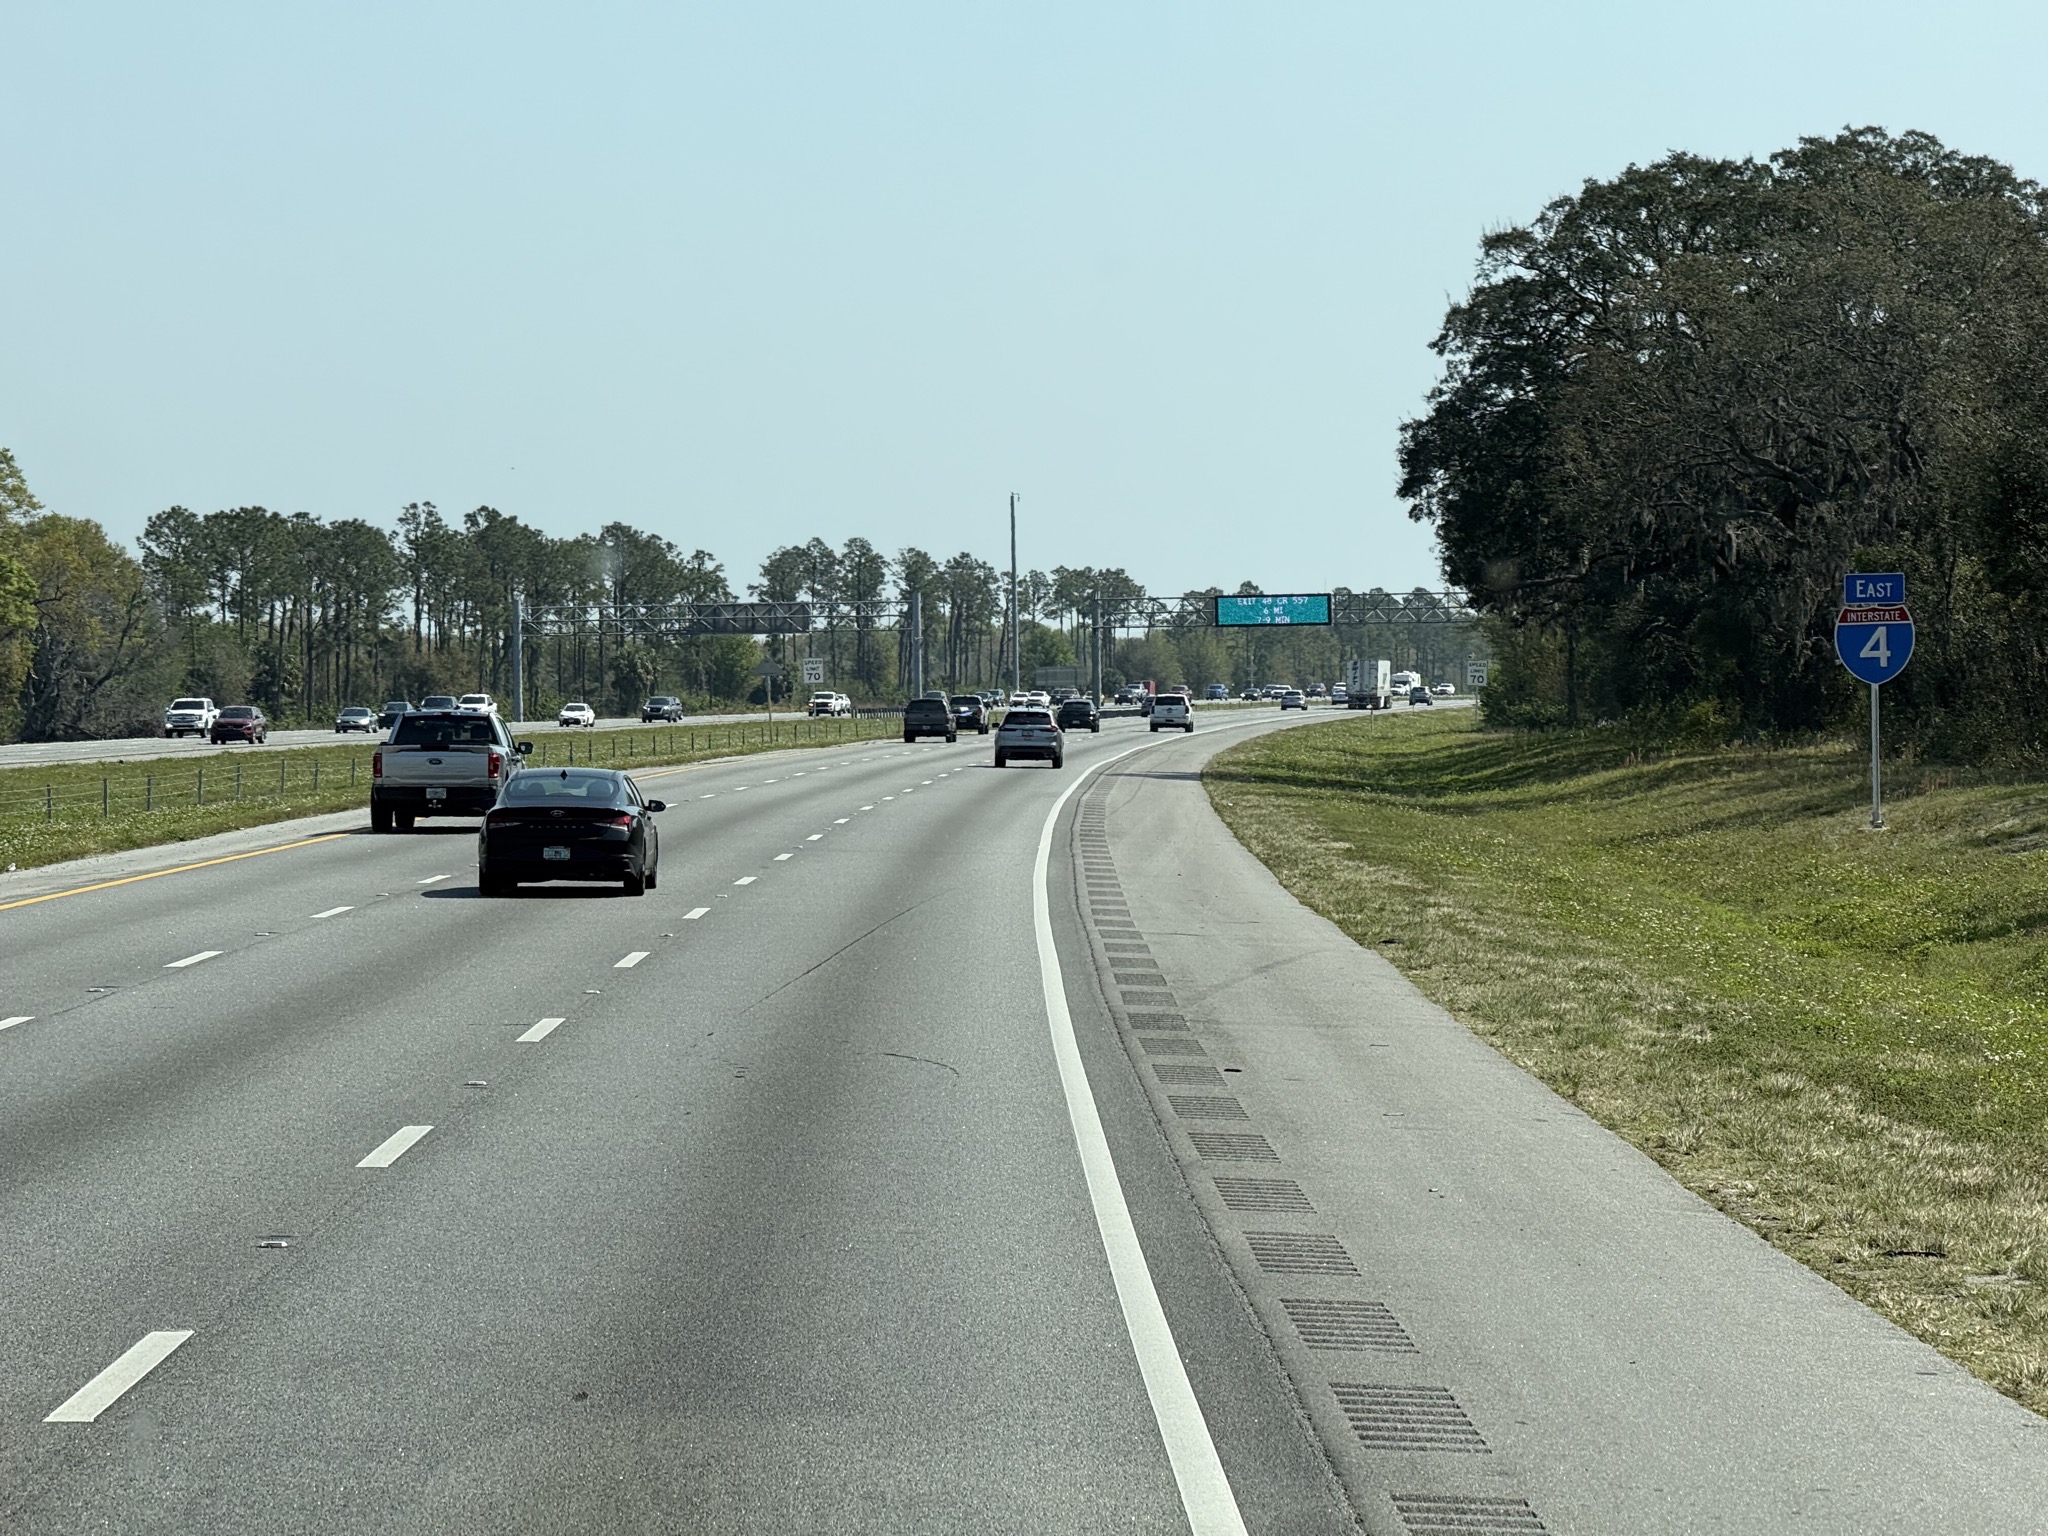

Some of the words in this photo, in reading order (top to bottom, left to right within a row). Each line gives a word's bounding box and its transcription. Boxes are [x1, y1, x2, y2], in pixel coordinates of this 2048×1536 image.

[1856, 580, 1893, 598] EAST
[1276, 597, 1288, 605] CR
[1292, 596, 1309, 605] 557
[1263, 606, 1269, 614] 6
[1273, 606, 1284, 614] MI
[1275, 616, 1290, 624] MIN
[1847, 611, 1901, 622] INTERSTATE
[1859, 626, 1892, 668] 4
[806, 672, 820, 680] 70
[1470, 675, 1484, 684] 70
